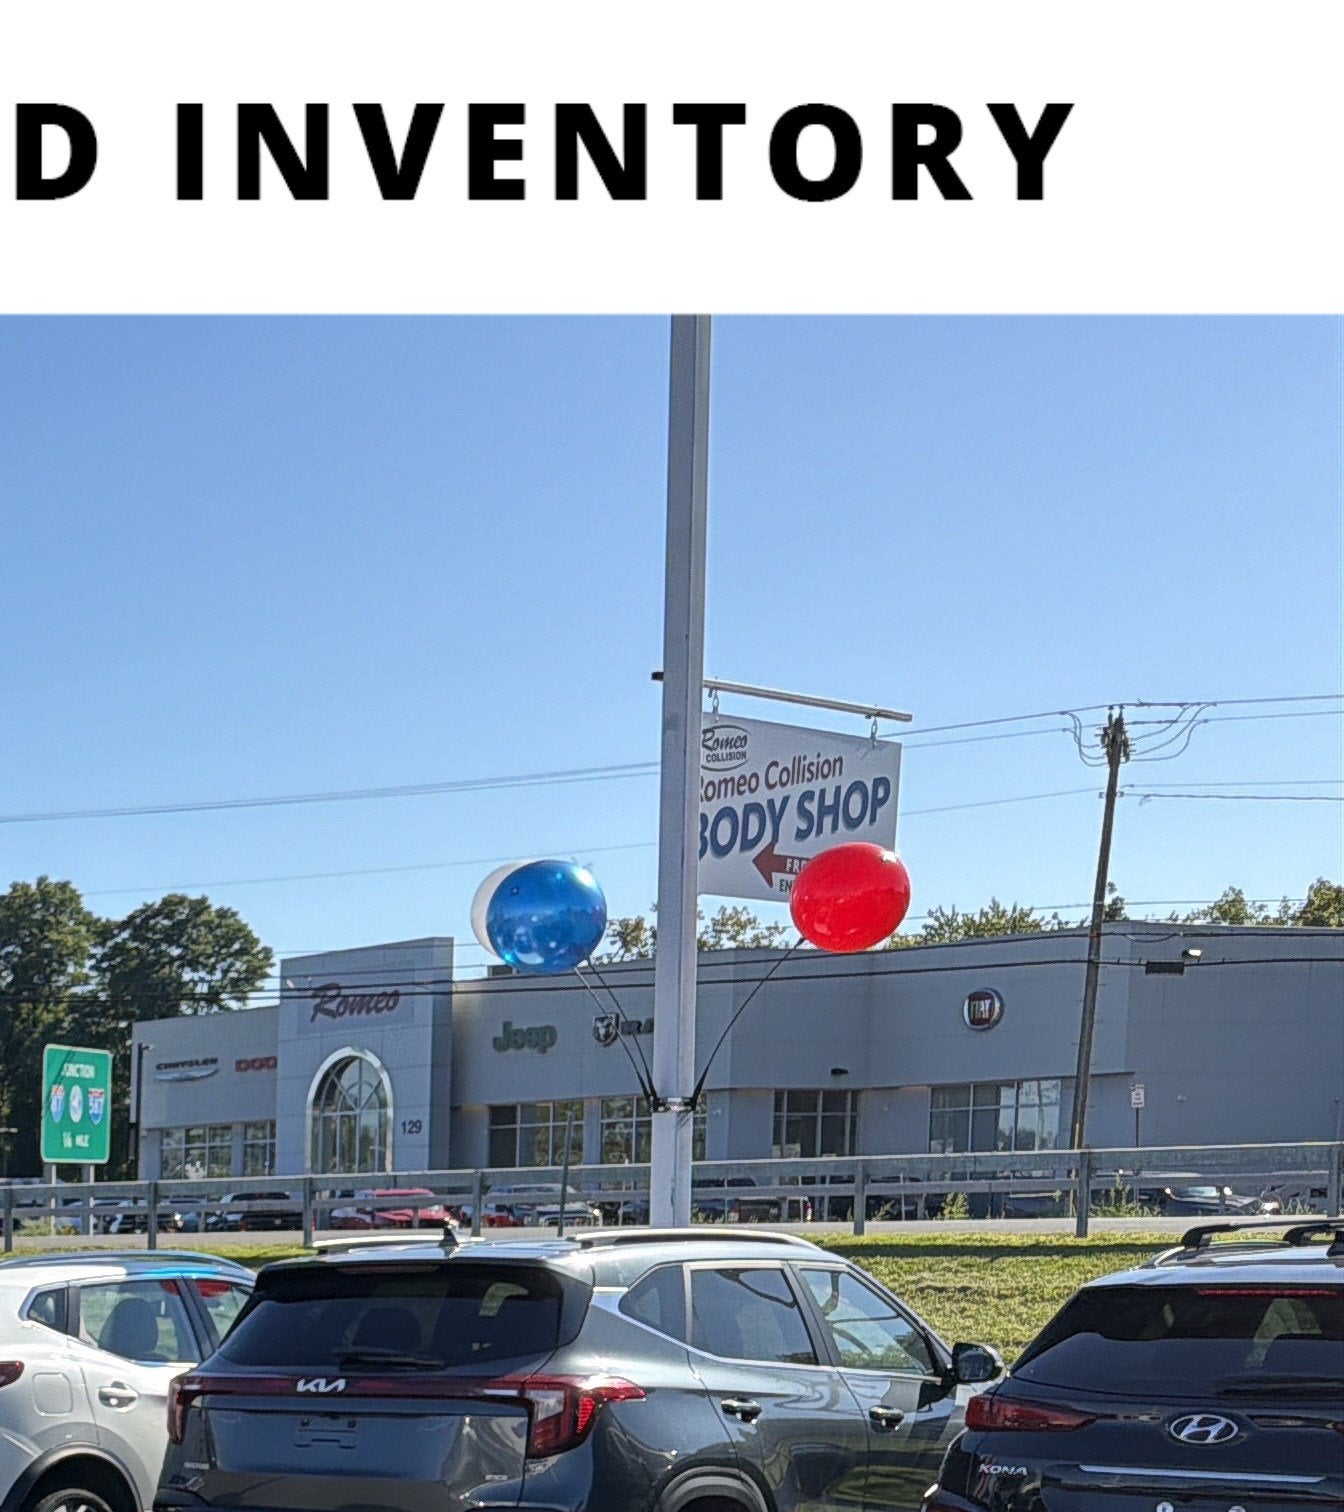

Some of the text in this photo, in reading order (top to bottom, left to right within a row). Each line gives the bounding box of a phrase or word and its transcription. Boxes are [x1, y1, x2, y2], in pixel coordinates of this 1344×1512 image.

[701, 728, 748, 751] Romeo
[706, 751, 747, 763] COLLISION
[700, 753, 844, 803] omeo Collision
[794, 776, 891, 842] SHOP
[310, 983, 400, 1023] Romeo
[492, 1021, 558, 1054] Jeep
[400, 1119, 423, 1135] 129
[296, 1378, 346, 1393] KIA
[978, 1464, 1028, 1476] KONA
